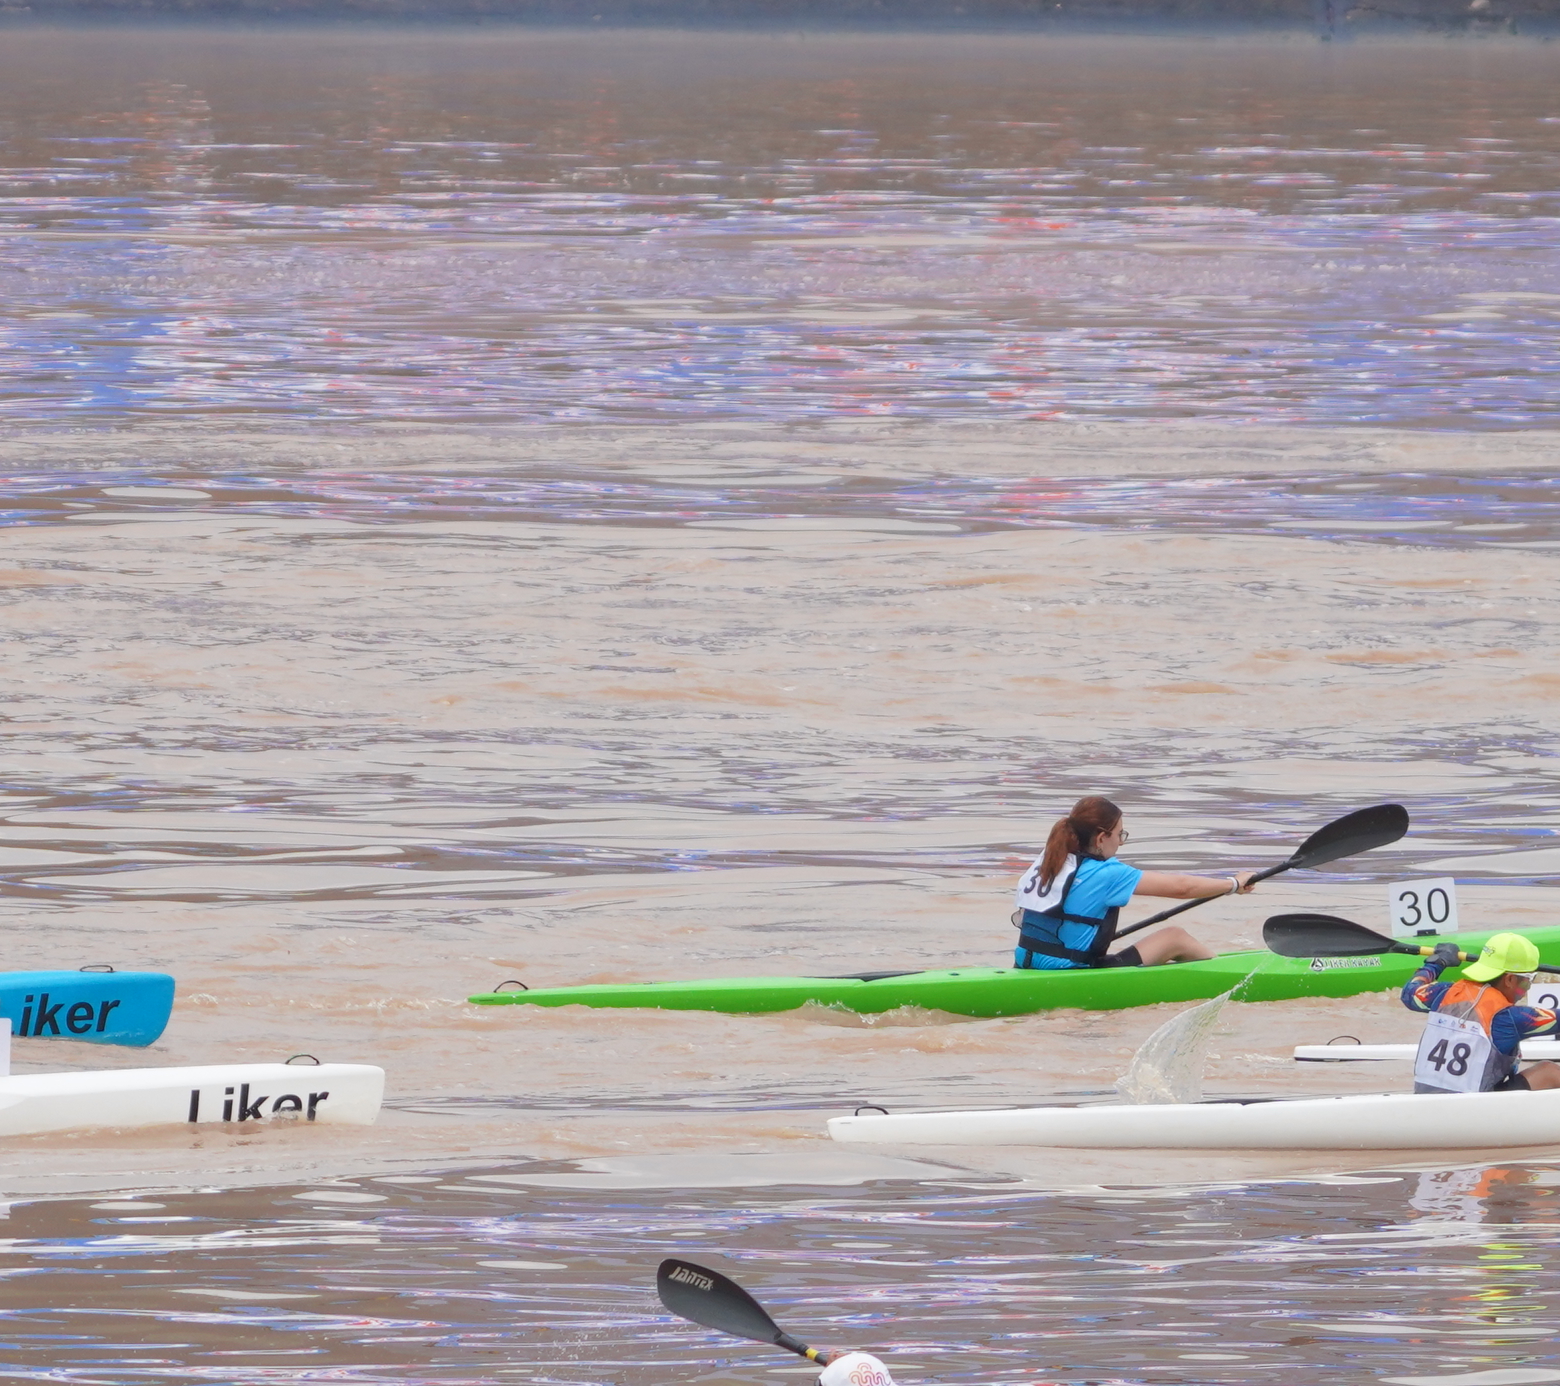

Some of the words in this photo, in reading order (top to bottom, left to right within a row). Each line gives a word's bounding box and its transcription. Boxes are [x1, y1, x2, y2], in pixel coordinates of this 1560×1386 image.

[1398, 887, 1450, 925] 30
[1427, 1039, 1471, 1077] 48
[187, 1083, 329, 1122] Liker
